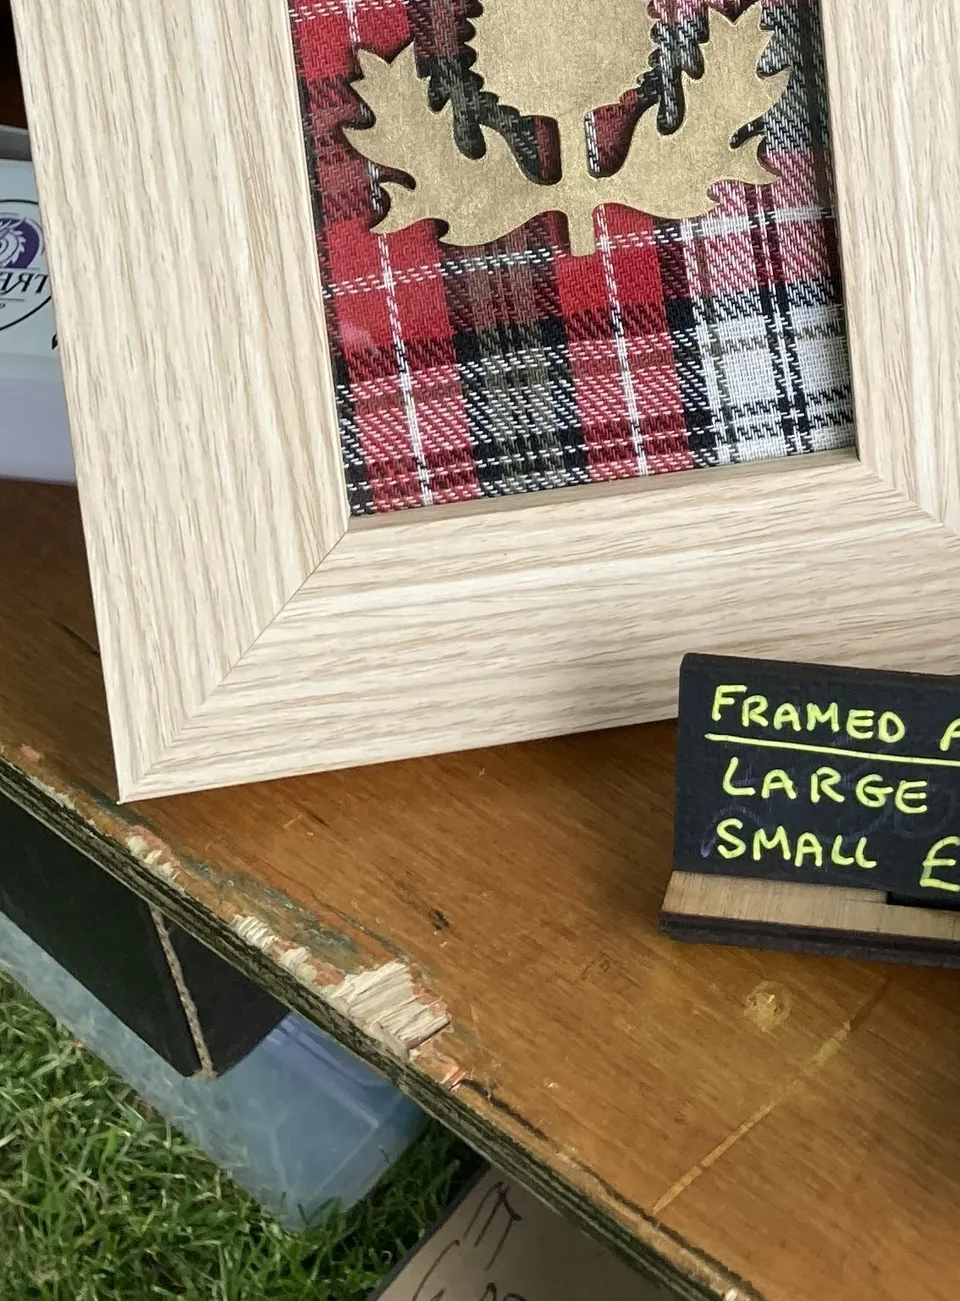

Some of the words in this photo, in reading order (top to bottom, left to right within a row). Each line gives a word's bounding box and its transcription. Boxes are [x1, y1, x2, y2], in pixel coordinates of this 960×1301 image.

[710, 684, 907, 744] FRAMED
[721, 756, 929, 815] LARGE
[716, 816, 878, 870] SMALL
